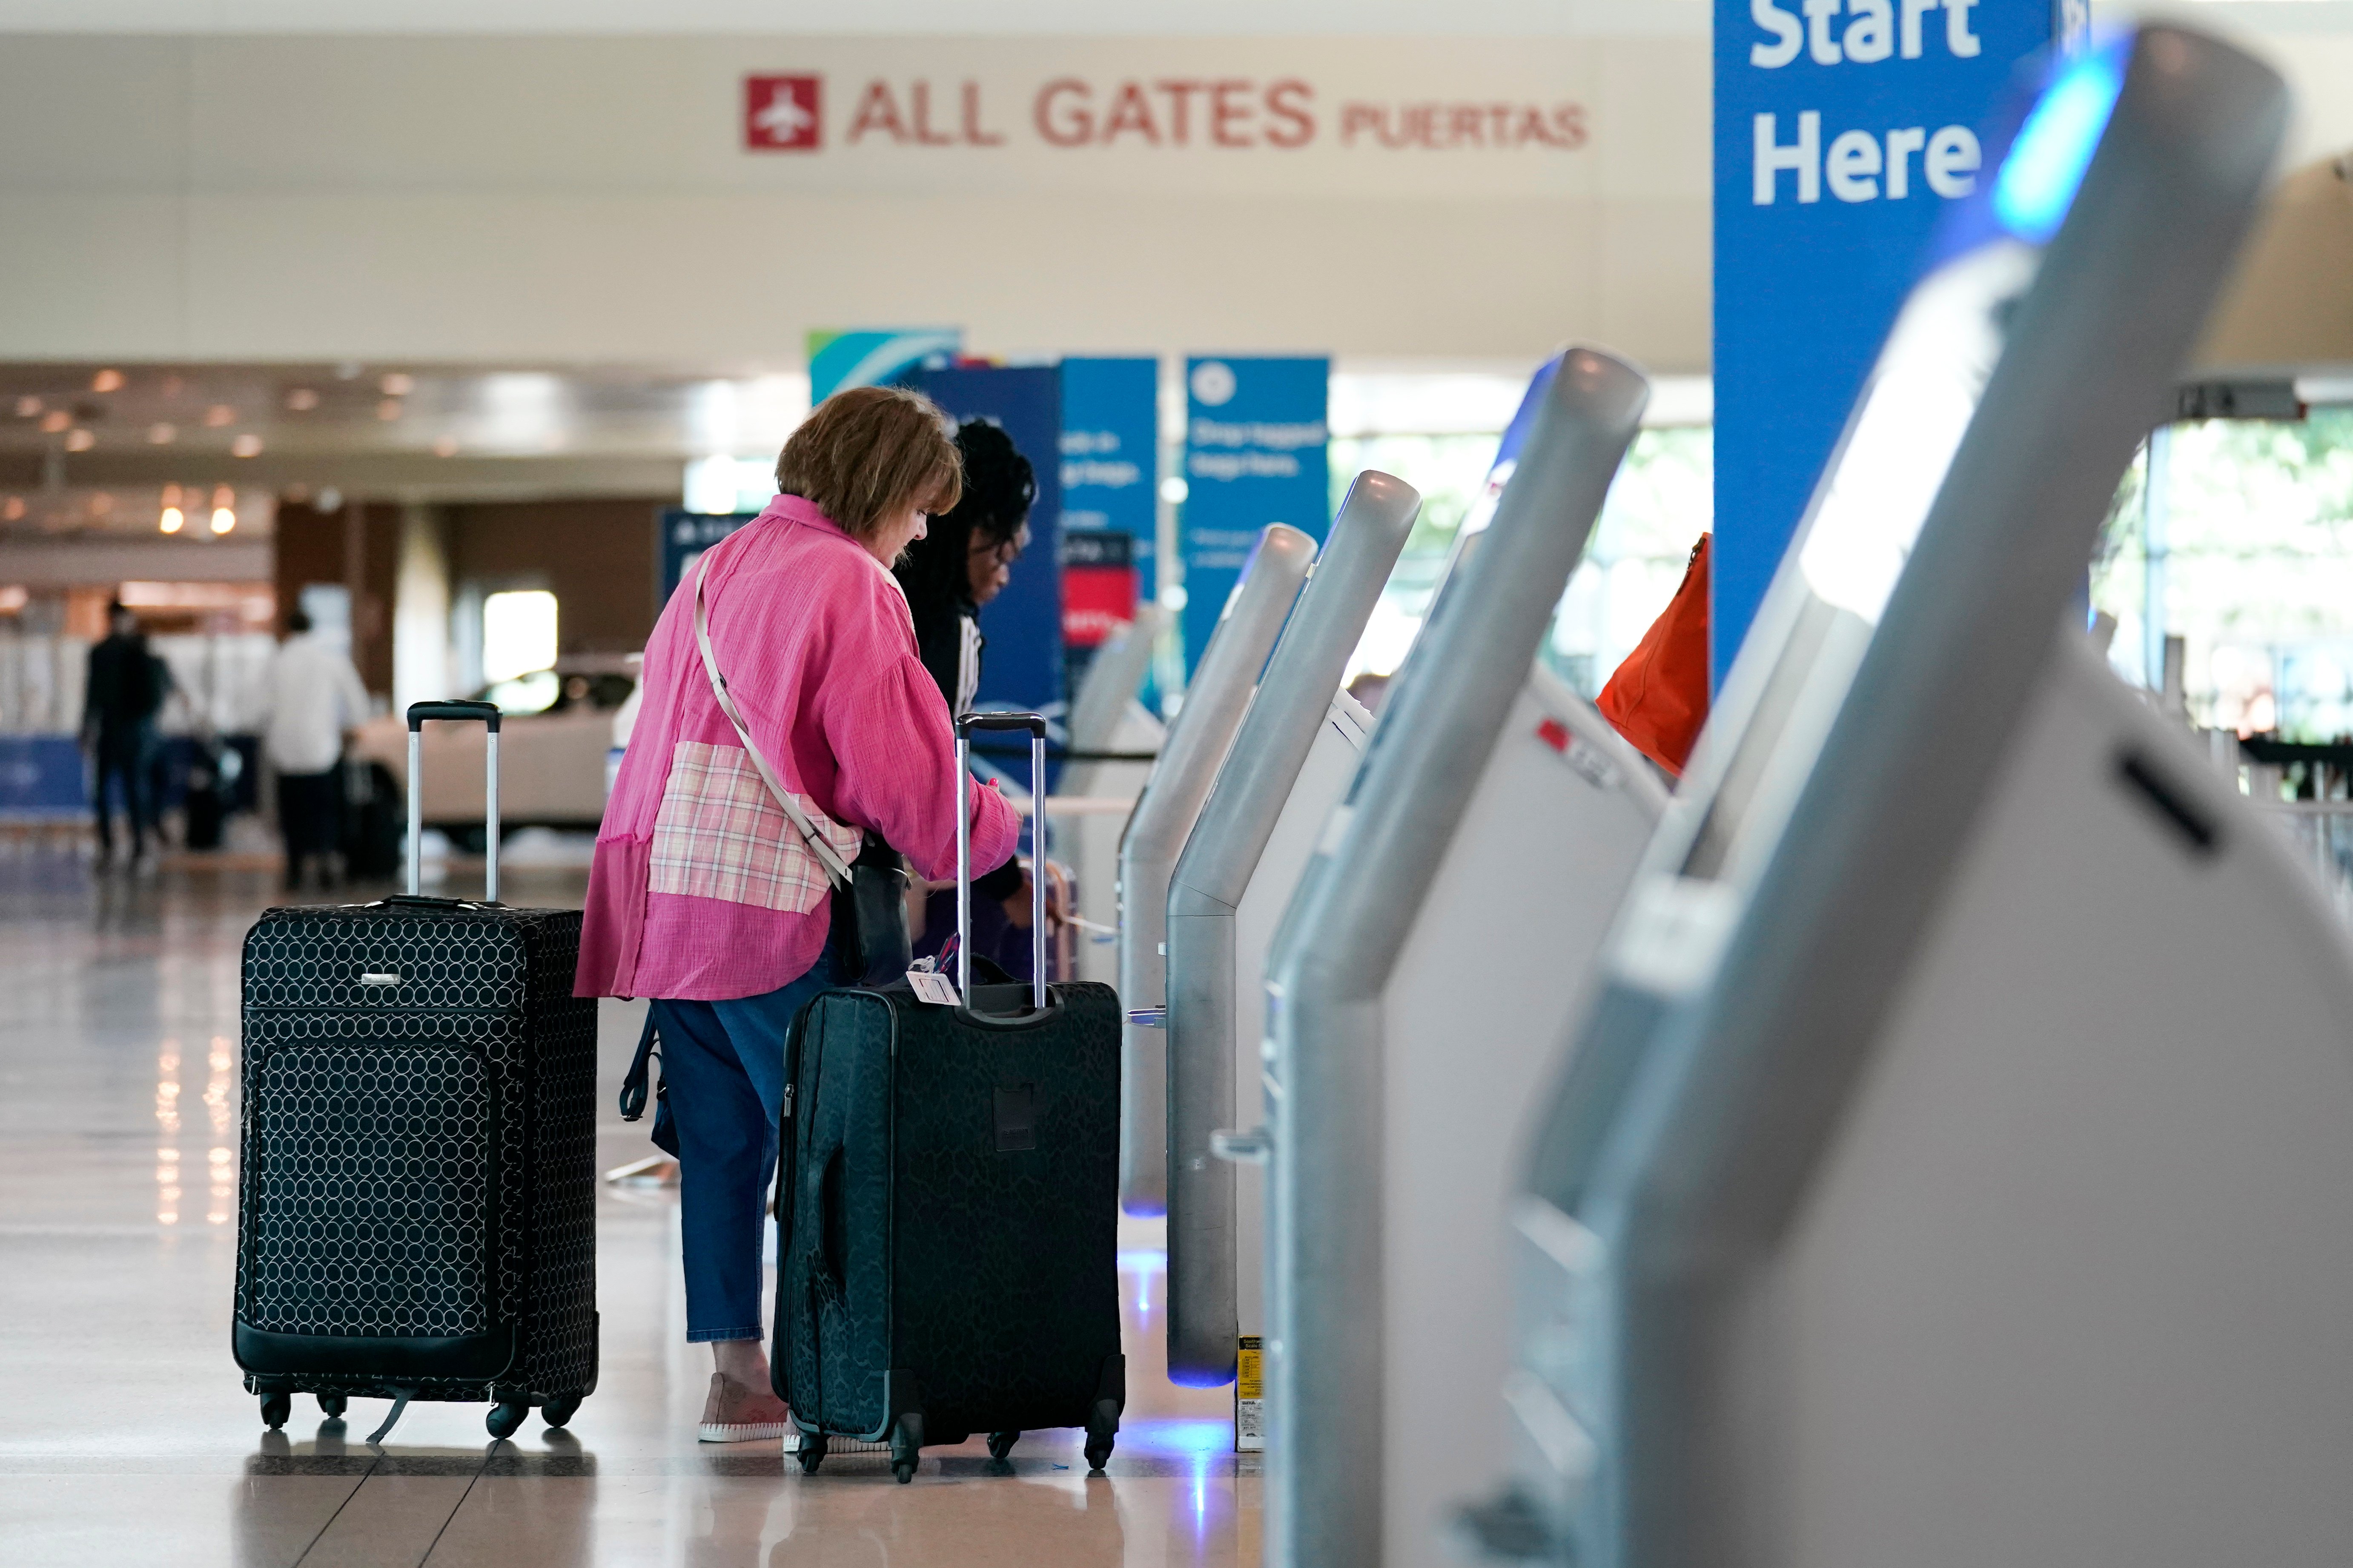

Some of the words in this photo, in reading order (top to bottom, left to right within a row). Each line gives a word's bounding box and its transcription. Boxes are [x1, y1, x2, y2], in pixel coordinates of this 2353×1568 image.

[1750, 0, 1981, 68] Start
[846, 77, 1006, 147] ALL
[1033, 78, 1315, 148] GATES
[1340, 101, 1588, 149] PUERTAS
[1752, 110, 1982, 205] Here
